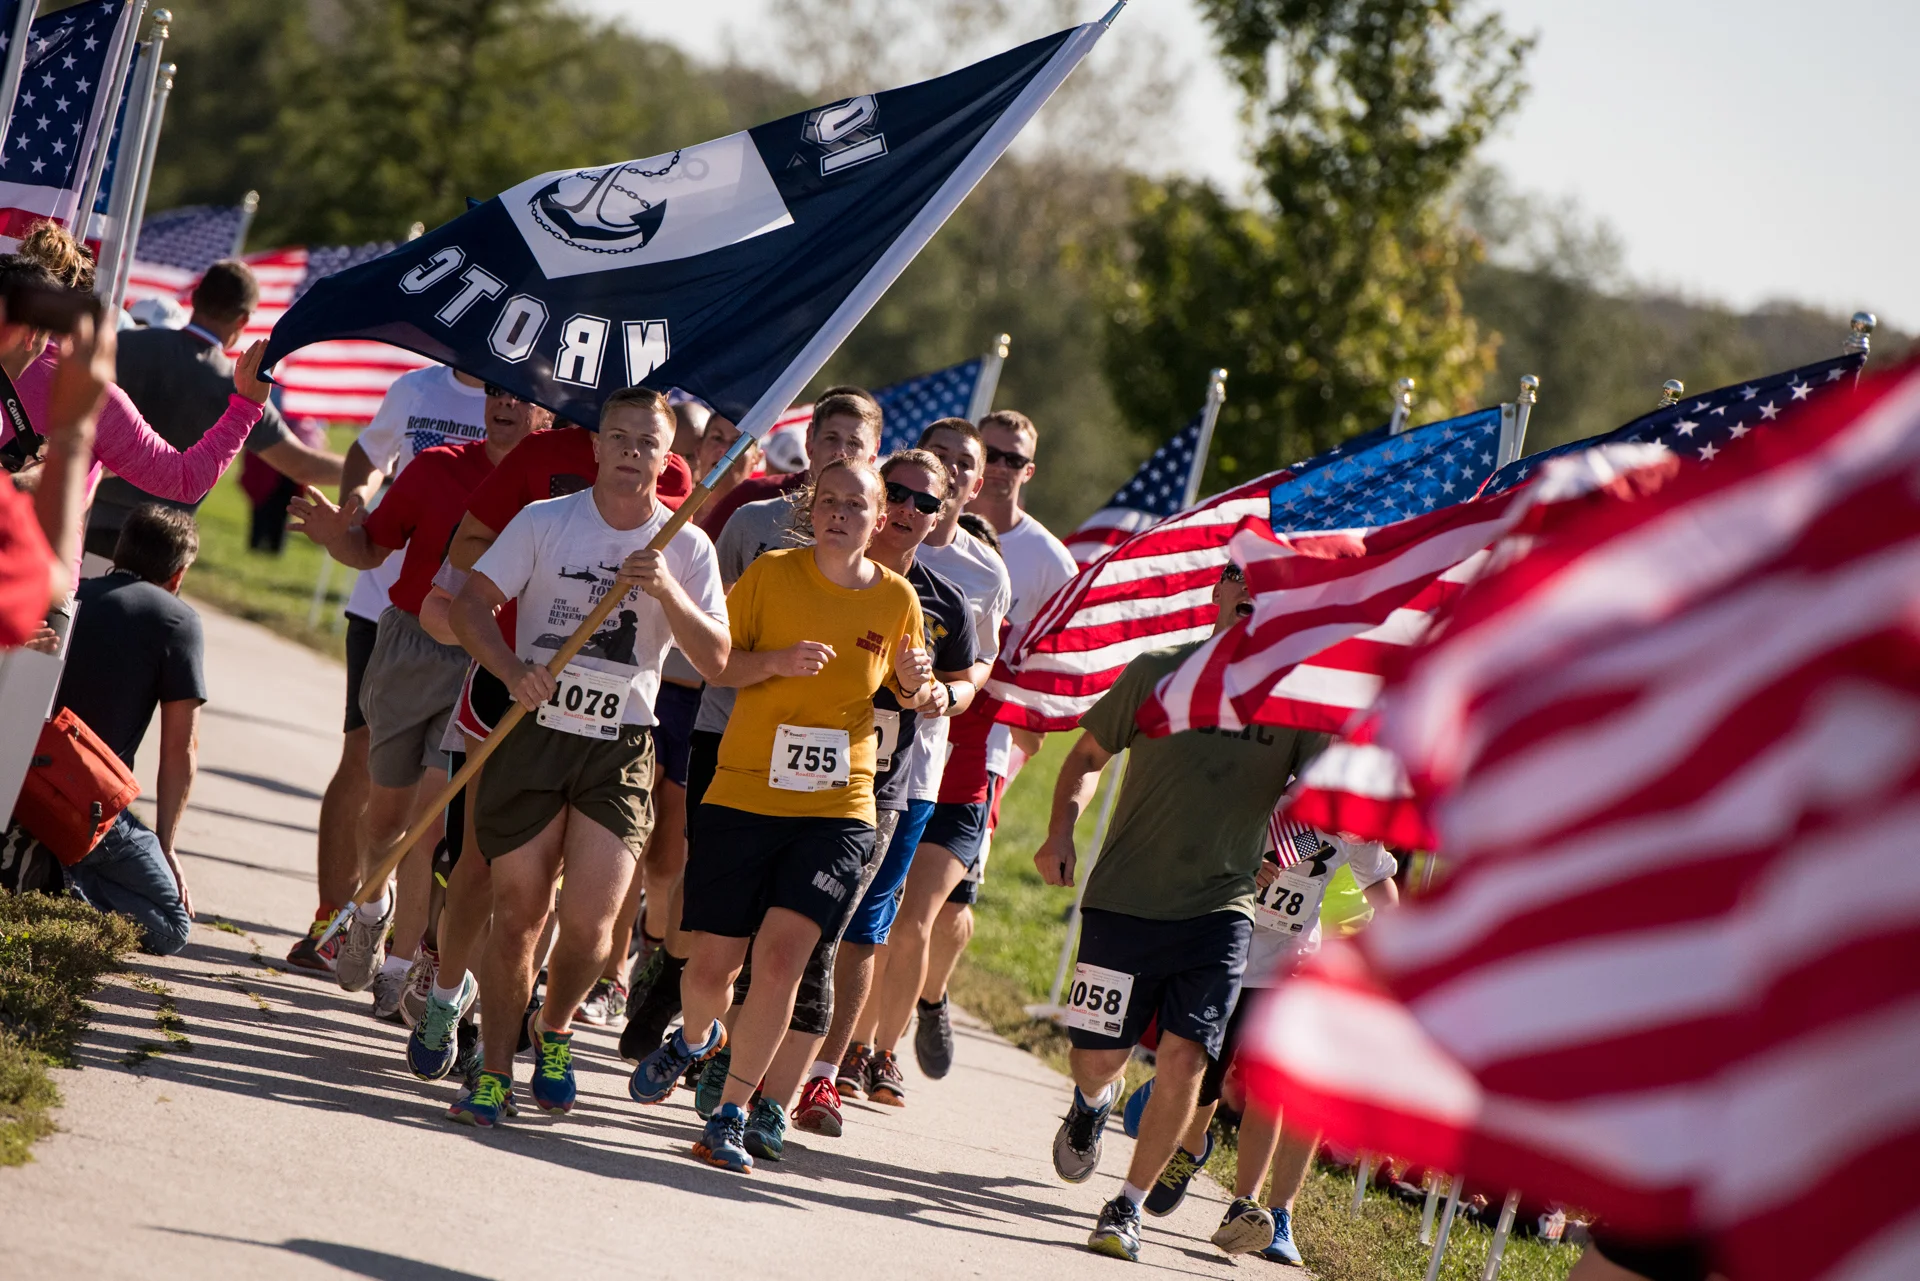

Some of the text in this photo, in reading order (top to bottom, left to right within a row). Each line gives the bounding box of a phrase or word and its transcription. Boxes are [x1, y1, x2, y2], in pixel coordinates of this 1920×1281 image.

[6, 398, 26, 432] Canon
[547, 617, 567, 626] RUN
[551, 604, 580, 613] ANNUAL
[548, 681, 620, 719] 1078
[787, 744, 837, 773] 755
[1256, 884, 1304, 916] 178
